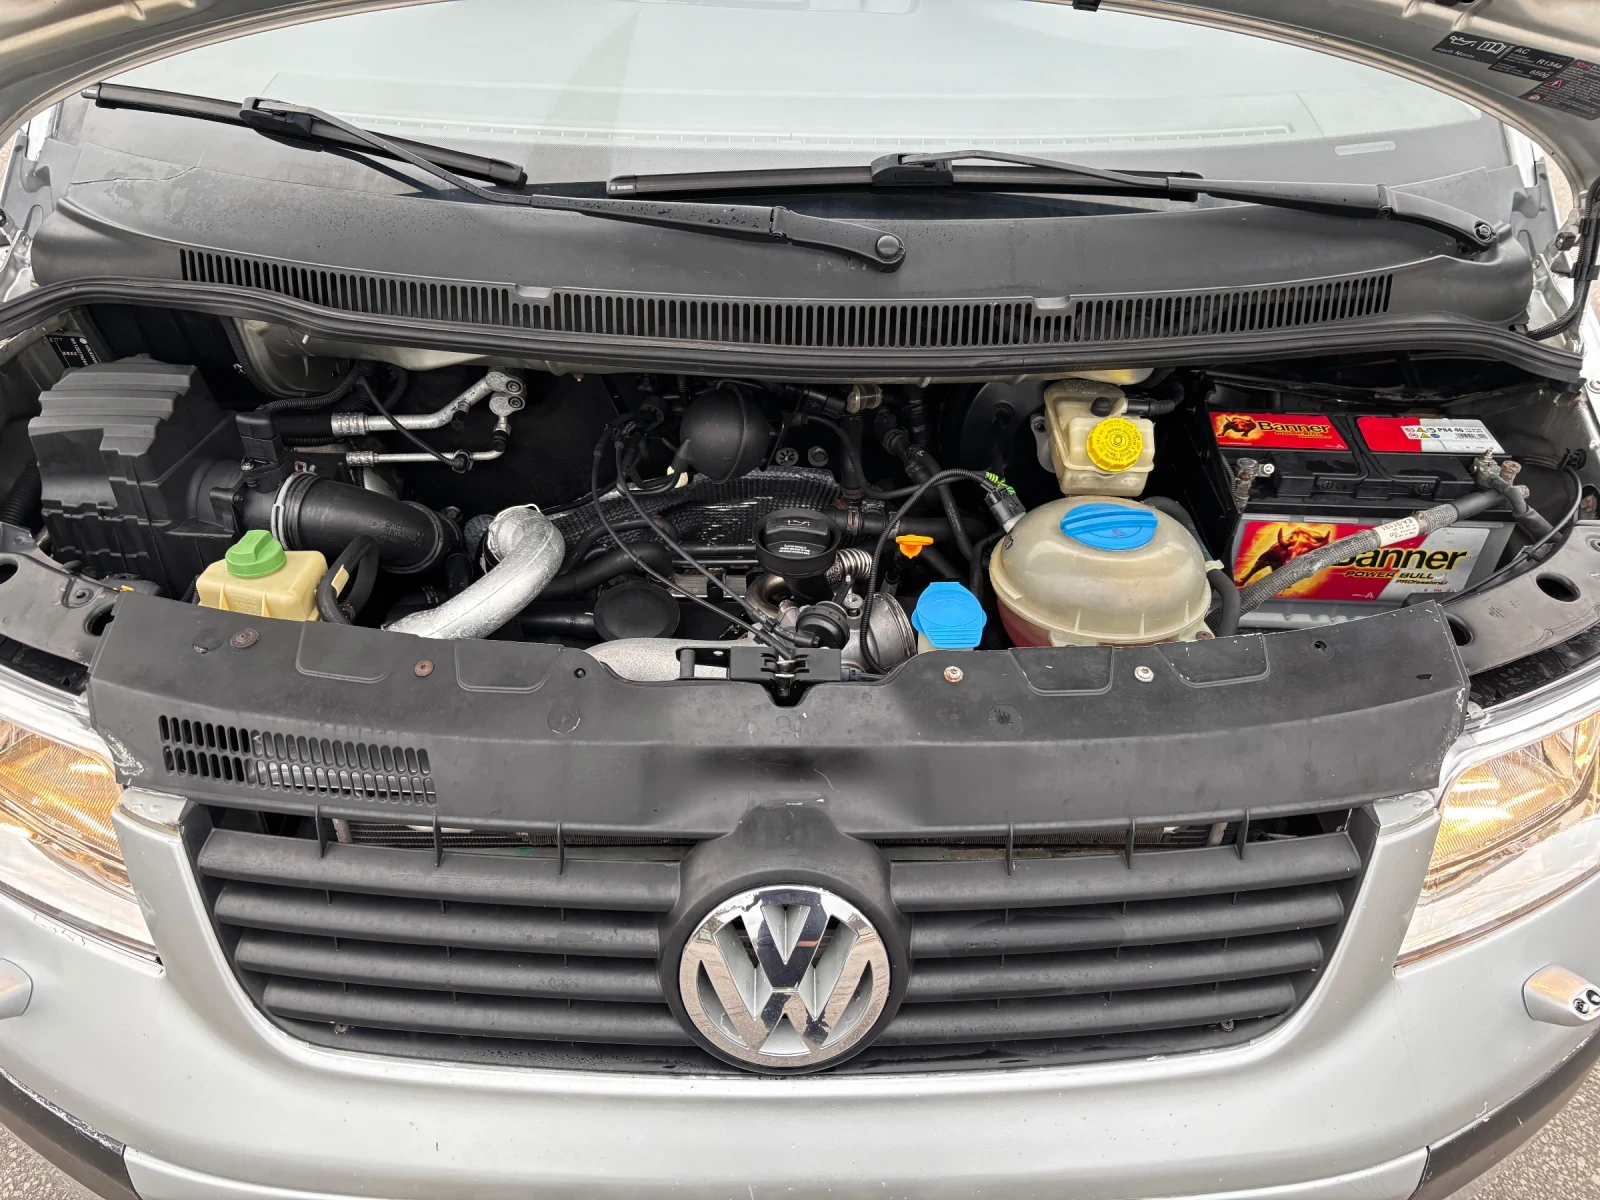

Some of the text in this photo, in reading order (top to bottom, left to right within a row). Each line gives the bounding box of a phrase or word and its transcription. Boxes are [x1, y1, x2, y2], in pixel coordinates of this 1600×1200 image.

[1515, 47, 1531, 55] AC
[1536, 58, 1563, 69] R134a
[1529, 69, 1551, 79] 650g
[1258, 421, 1329, 433] Banner
[1398, 572, 1434, 580] BULL
